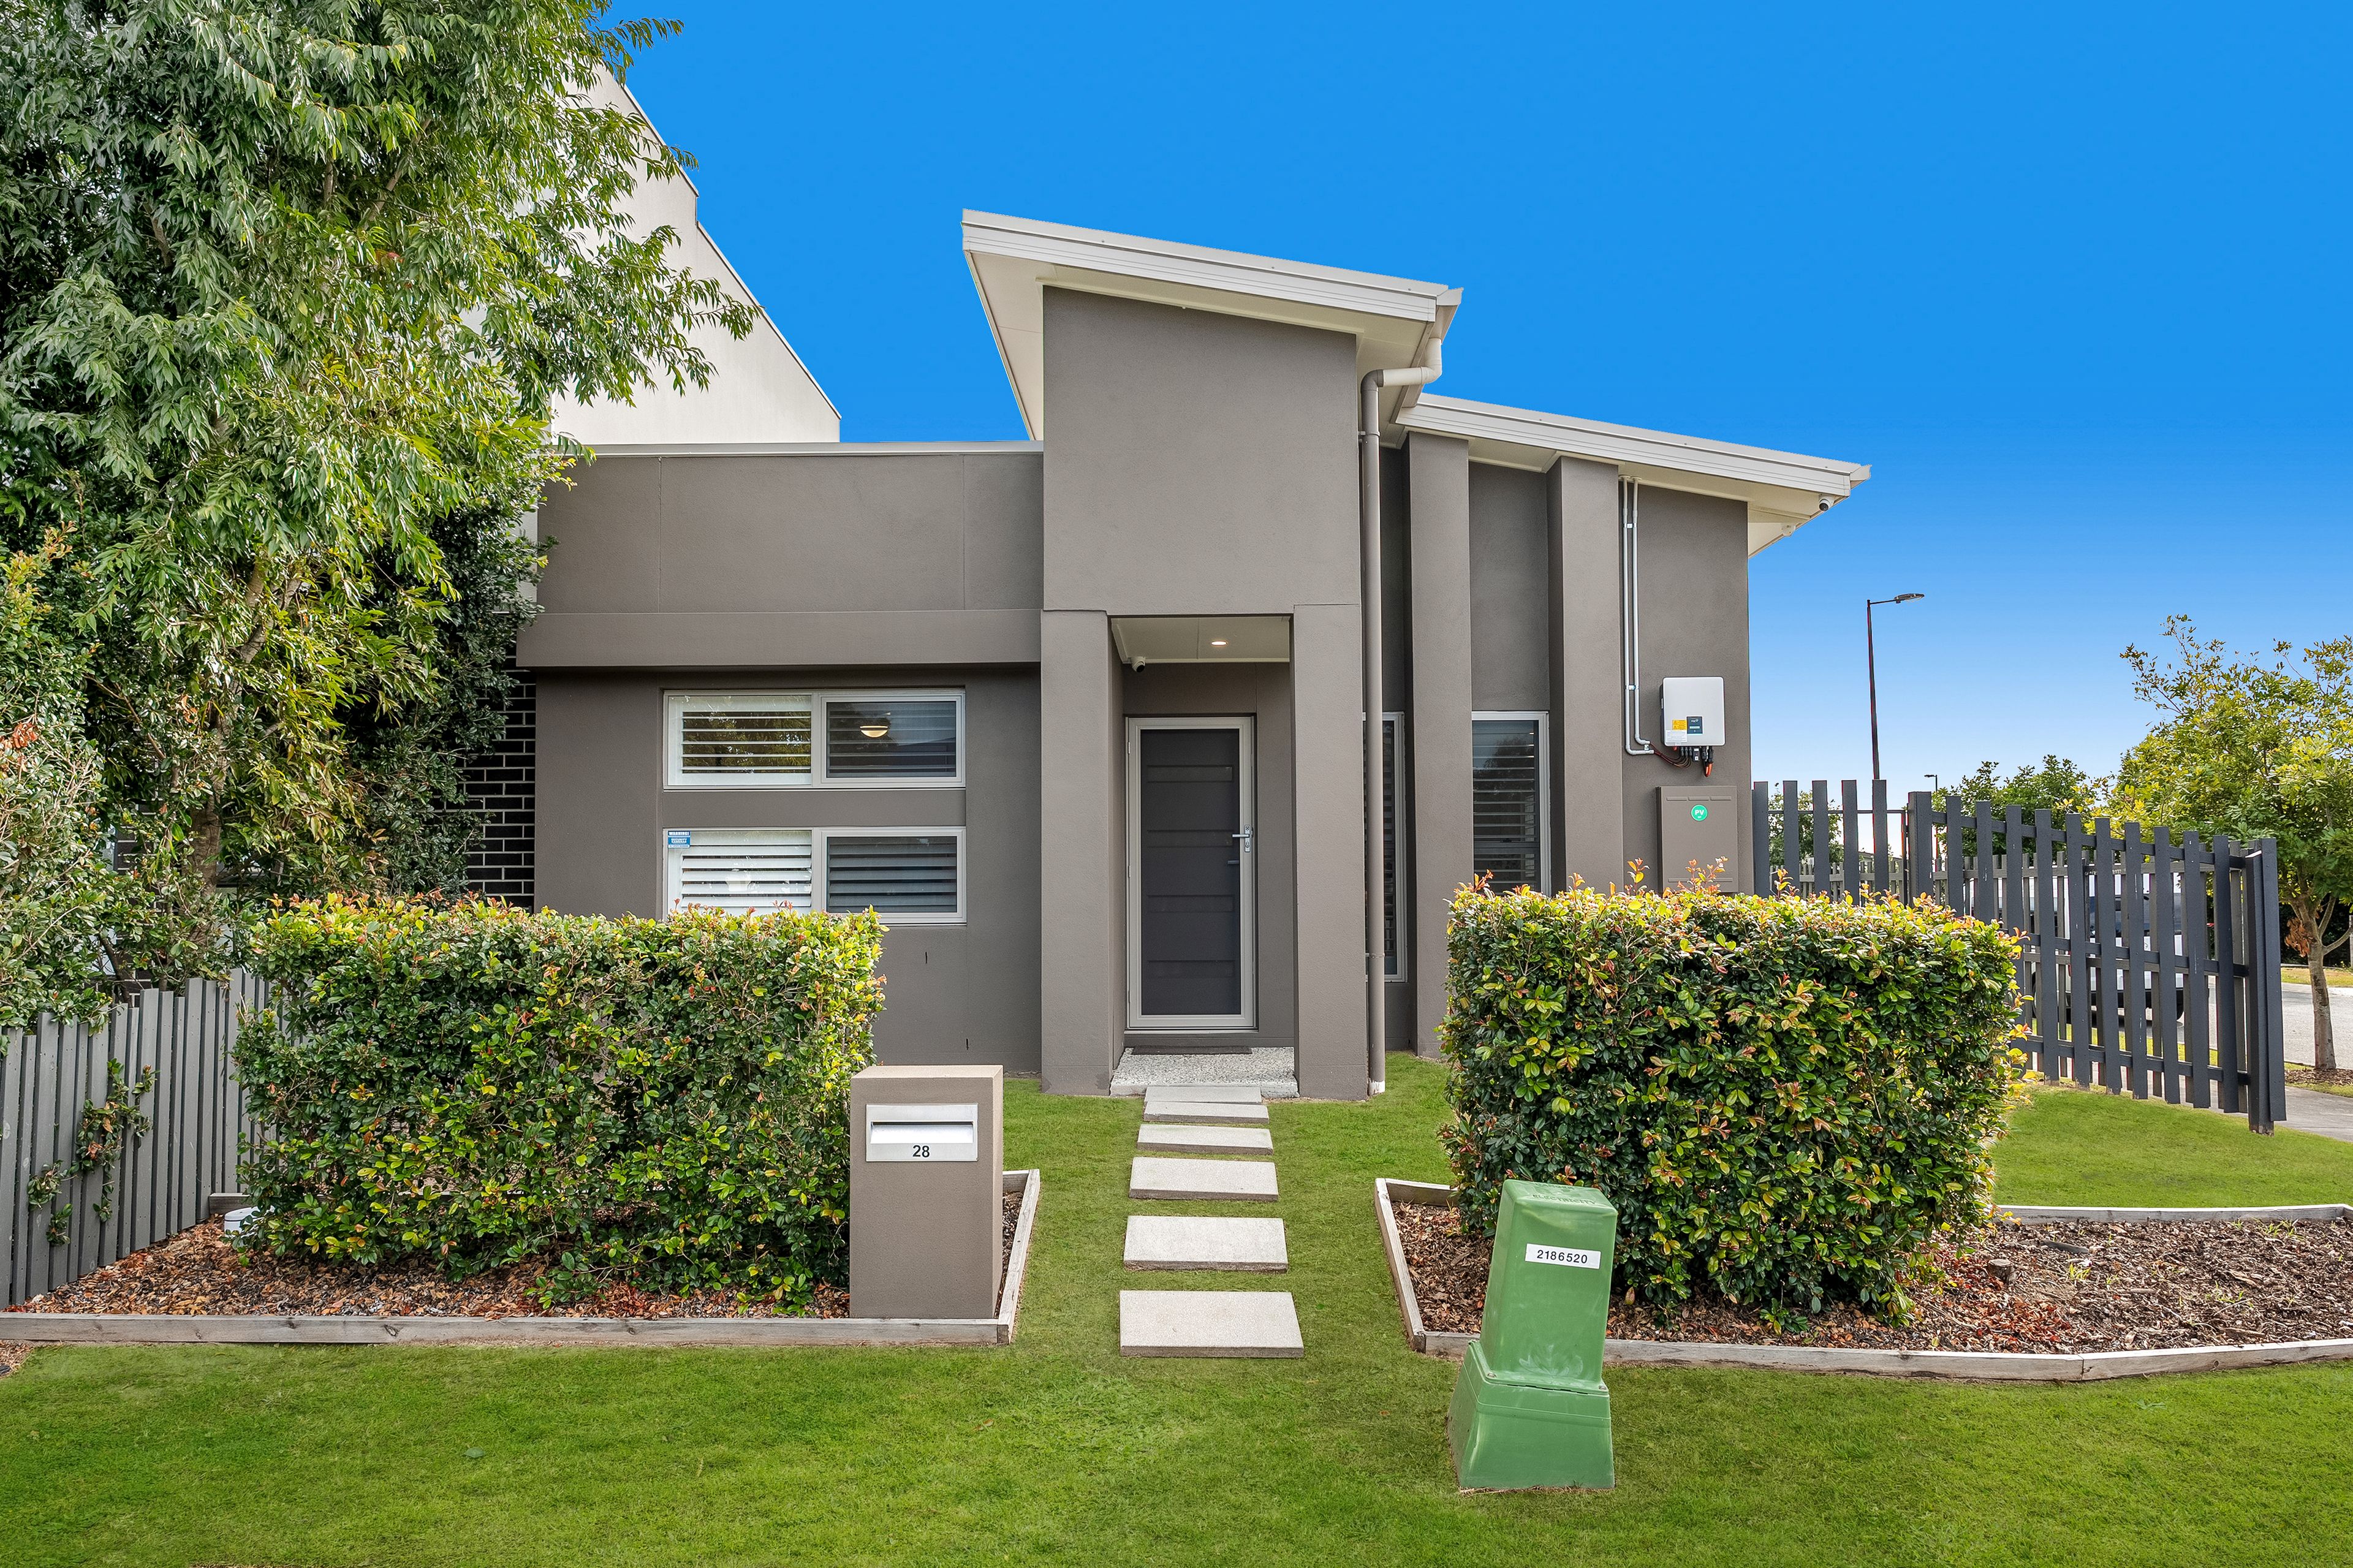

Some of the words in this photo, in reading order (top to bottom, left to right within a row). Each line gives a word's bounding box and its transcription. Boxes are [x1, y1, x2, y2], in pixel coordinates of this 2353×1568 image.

[912, 1145, 930, 1157] 28
[1533, 1194, 1596, 1204] ELECTRICITY
[1537, 1249, 1588, 1263] 2186520
